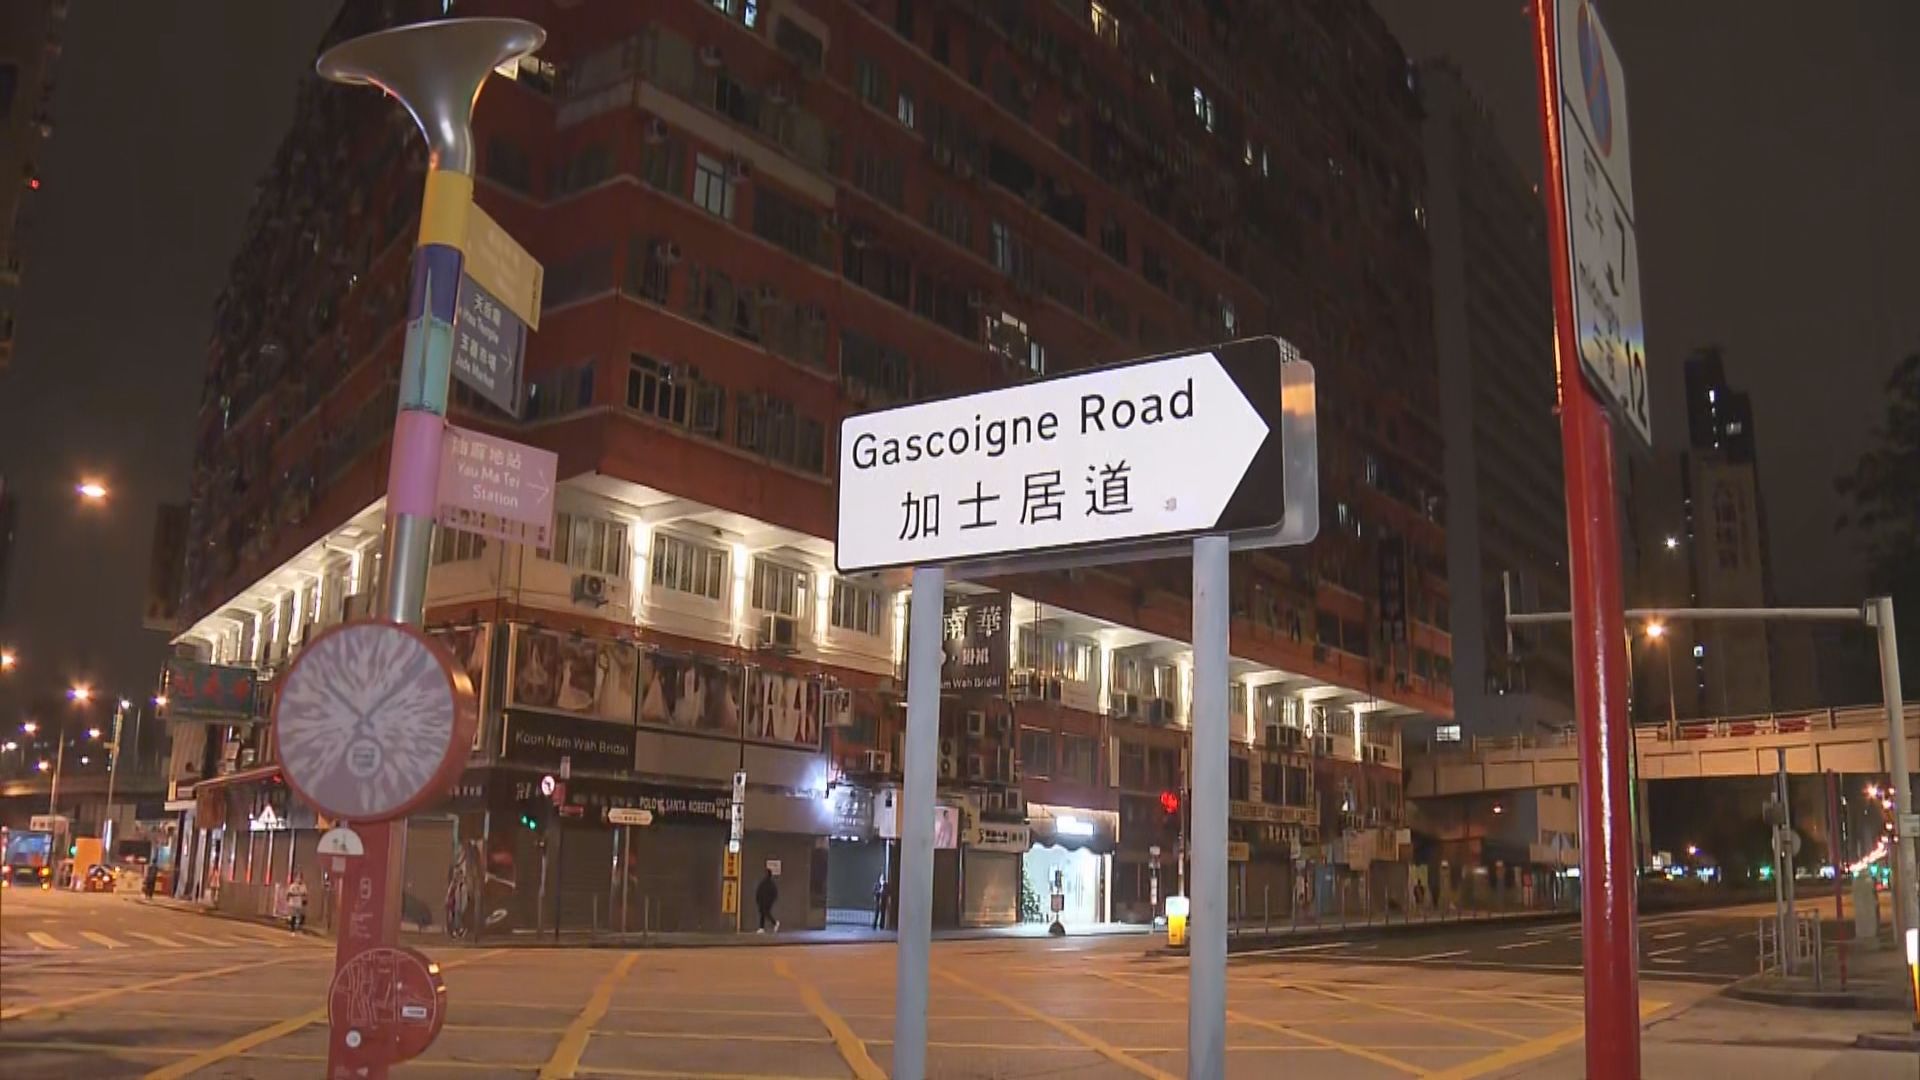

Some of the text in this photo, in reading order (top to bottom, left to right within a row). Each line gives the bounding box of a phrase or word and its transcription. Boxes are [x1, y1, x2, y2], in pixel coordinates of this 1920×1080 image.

[852, 377, 1194, 469] Gascoigne Road
[457, 461, 520, 489] Yau Ma Tei
[472, 484, 518, 509] Station
[899, 459, 1133, 541] 加士居道
[973, 674, 1001, 688] Bridal
[515, 730, 629, 756] Koon Nam Wah Bridal
[639, 795, 657, 811] POLO
[665, 798, 687, 813] SANTA
